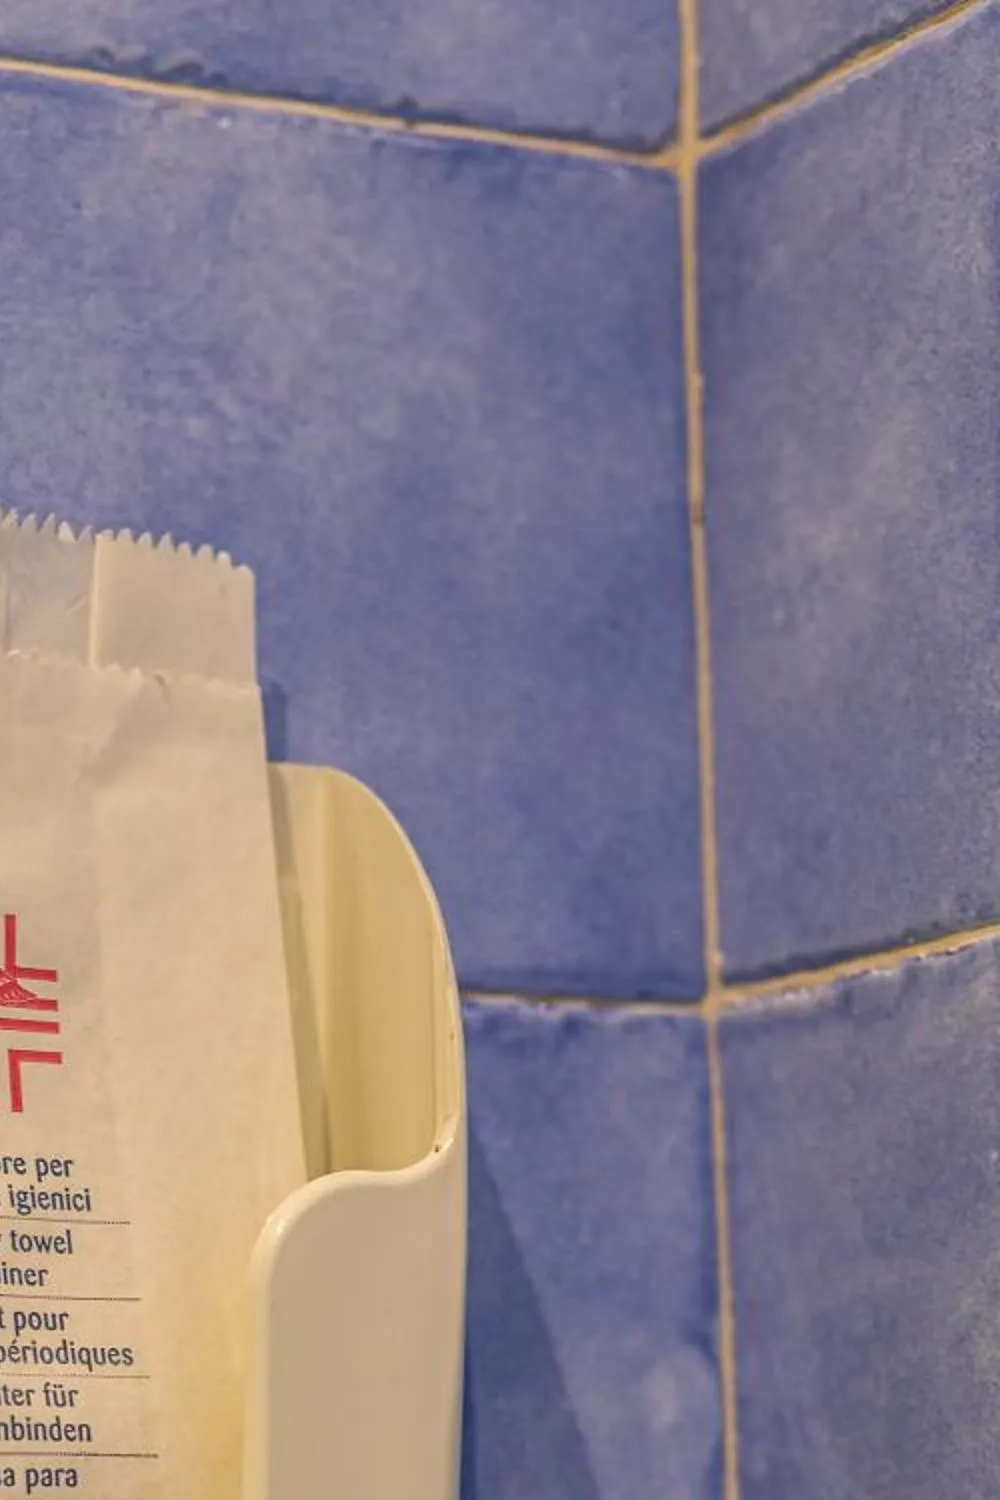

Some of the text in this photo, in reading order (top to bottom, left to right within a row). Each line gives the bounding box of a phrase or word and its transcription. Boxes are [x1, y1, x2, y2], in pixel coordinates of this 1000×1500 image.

[35, 1153, 75, 1182] per
[7, 1184, 92, 1215] igienici
[11, 1229, 74, 1255] towel
[13, 1309, 69, 1336] pour
[42, 1381, 79, 1408] für
[25, 1466, 79, 1494] para
